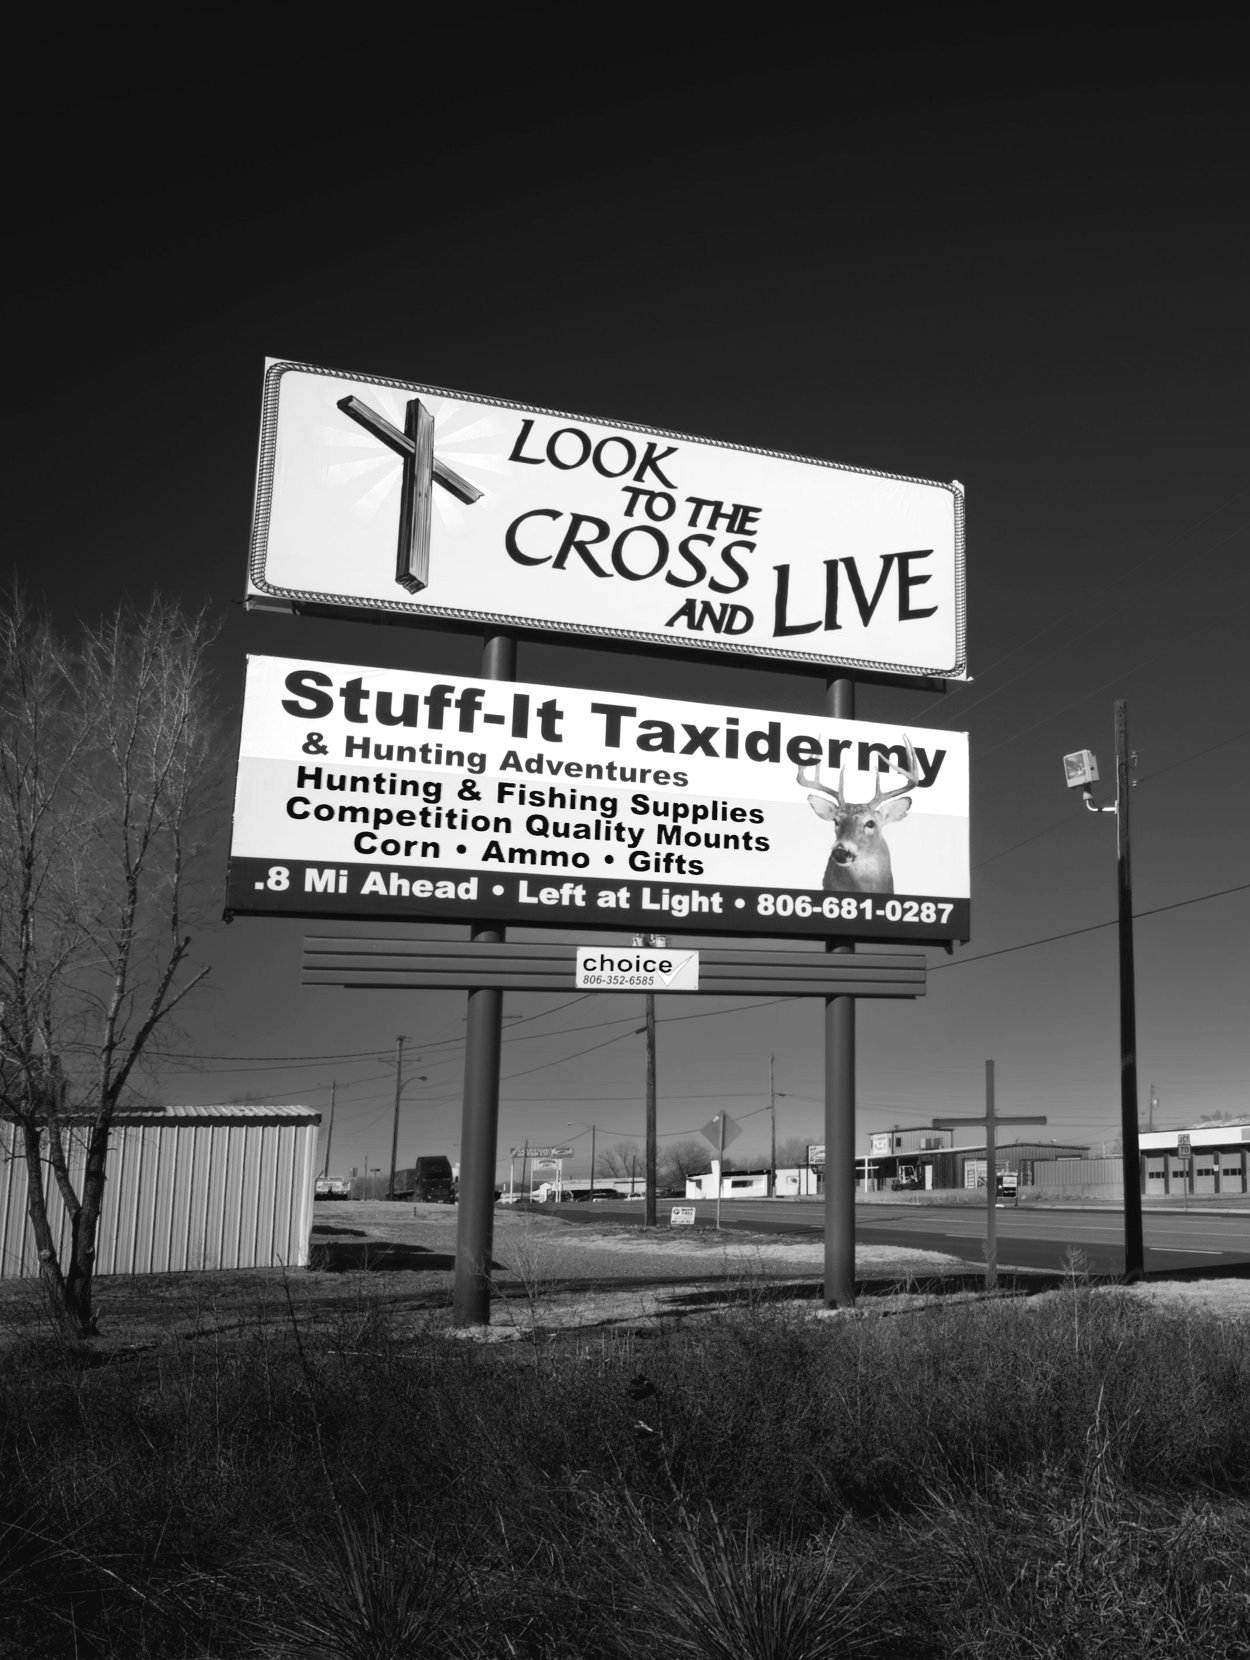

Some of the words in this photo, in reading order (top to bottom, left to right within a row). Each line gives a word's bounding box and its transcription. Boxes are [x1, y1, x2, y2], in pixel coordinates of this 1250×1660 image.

[508, 419, 679, 489] LOOK
[621, 486, 676, 522] TO
[685, 497, 762, 536] THE
[505, 509, 757, 594] CROSS
[664, 598, 754, 635] AND
[772, 549, 938, 637] LIVE
[281, 670, 564, 743] Stuff-It
[591, 702, 947, 788] Taxidermy
[301, 732, 329, 756] &
[345, 735, 487, 774] Hunting
[499, 750, 689, 787] Adventures
[297, 765, 442, 804] Hunting
[457, 779, 481, 801] &
[497, 782, 618, 818] Fishing
[631, 793, 765, 824] Supplies
[286, 796, 512, 833] Competition
[526, 814, 645, 849] Quality
[657, 824, 770, 851] Mounts
[354, 831, 440, 858] Corn
[481, 840, 590, 868] Ammo
[629, 850, 704, 875] Gifts
[254, 866, 290, 891] .8
[304, 868, 348, 894] Mi
[360, 871, 478, 900] Ahead
[519, 880, 586, 906] Left
[597, 887, 630, 909] at
[641, 887, 723, 917] Light
[757, 893, 954, 924] 806-681-0287
[583, 954, 672, 973] choice
[583, 975, 654, 985] 806-352-6585
